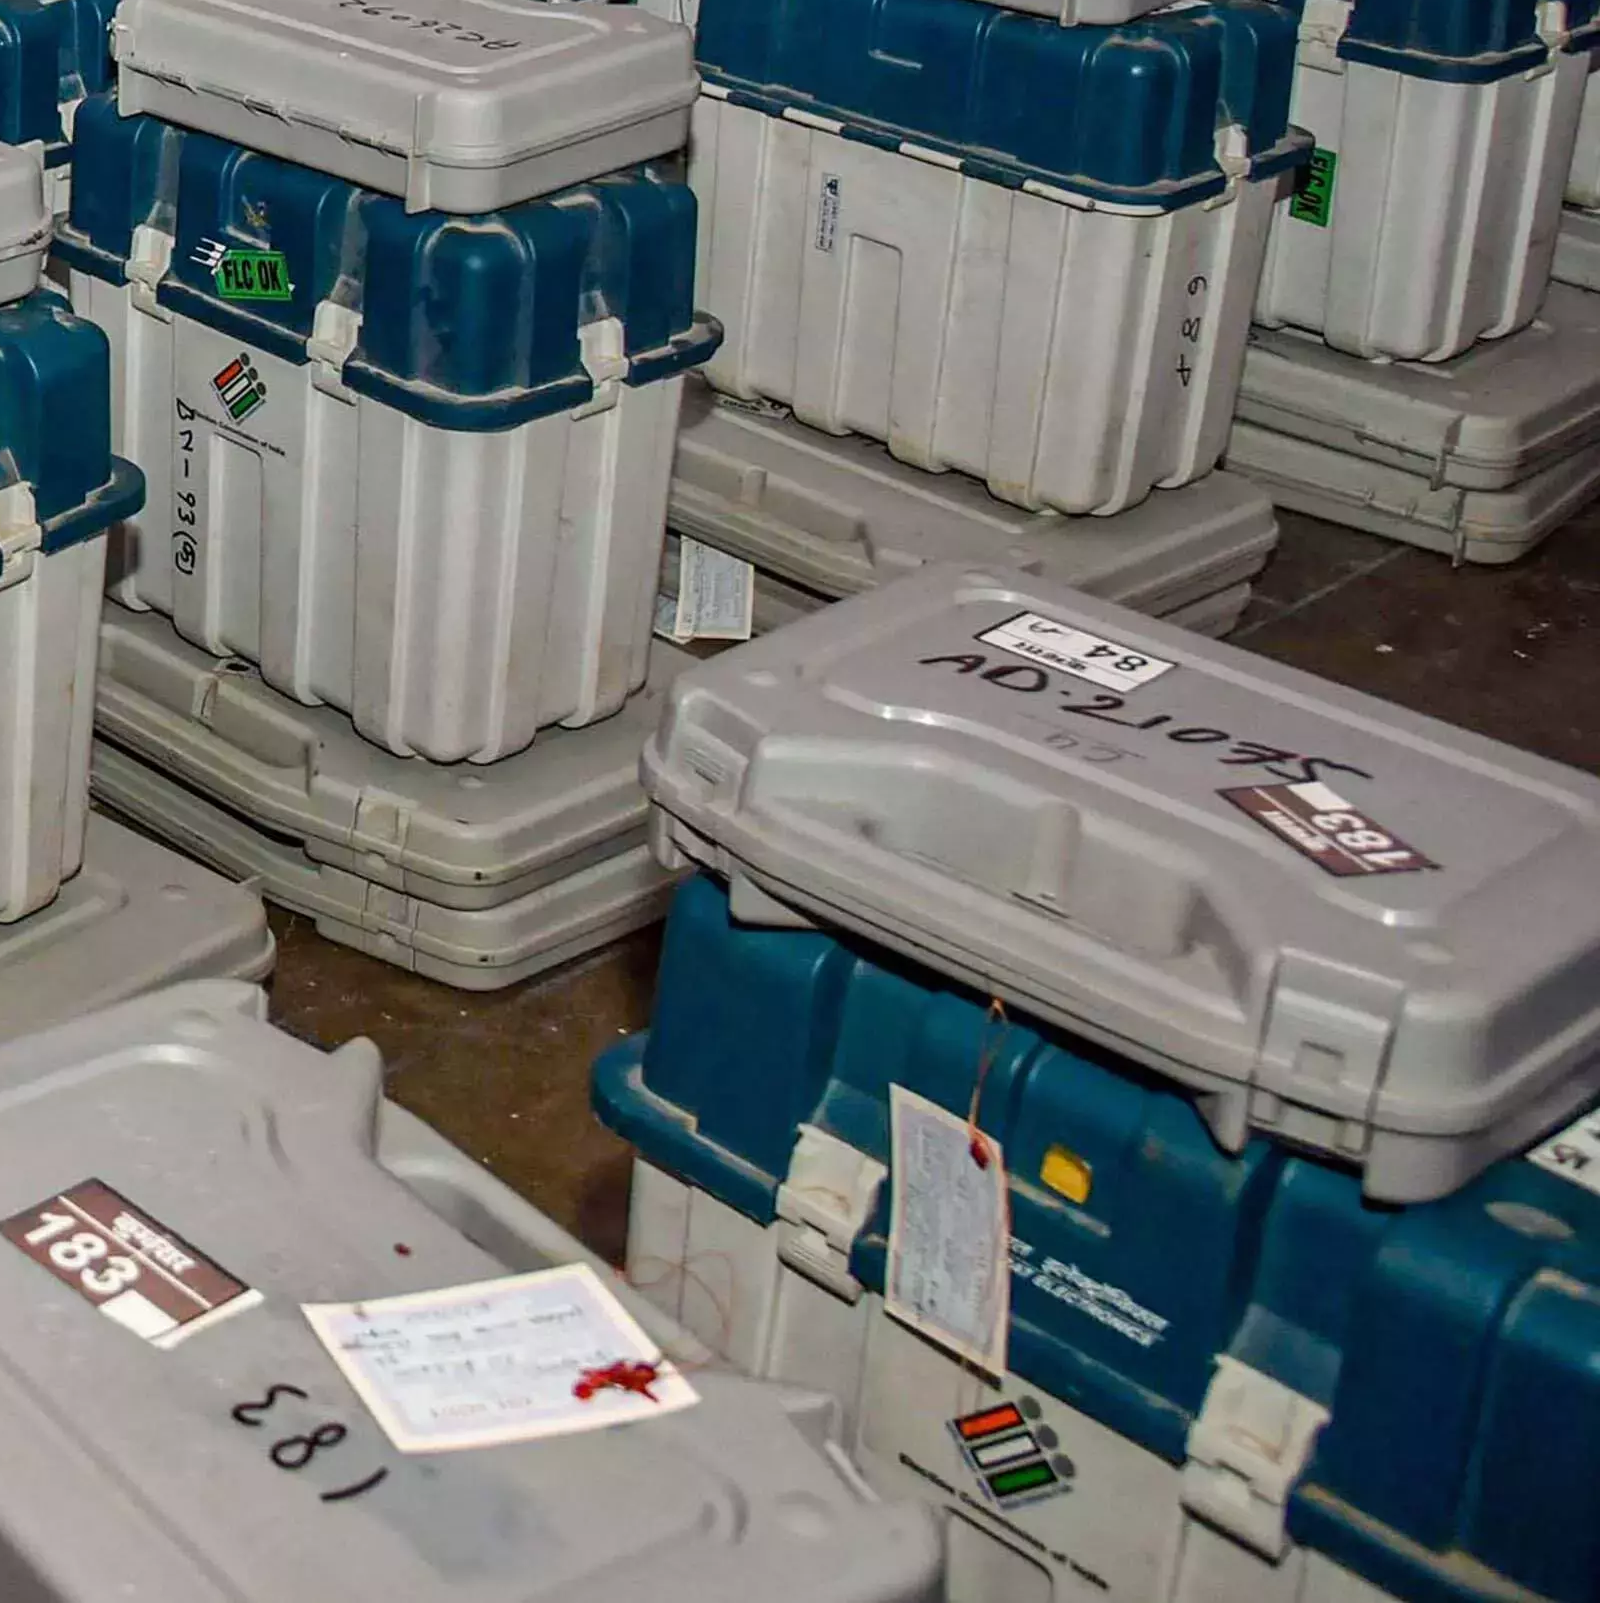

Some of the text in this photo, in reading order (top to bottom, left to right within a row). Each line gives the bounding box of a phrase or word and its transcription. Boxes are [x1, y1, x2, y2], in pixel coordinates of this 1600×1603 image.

[222, 256, 285, 293] FLC OK
[1091, 641, 1150, 677] 84
[1308, 808, 1411, 868] 183
[23, 1209, 143, 1298] 183
[231, 1382, 389, 1504] 183
